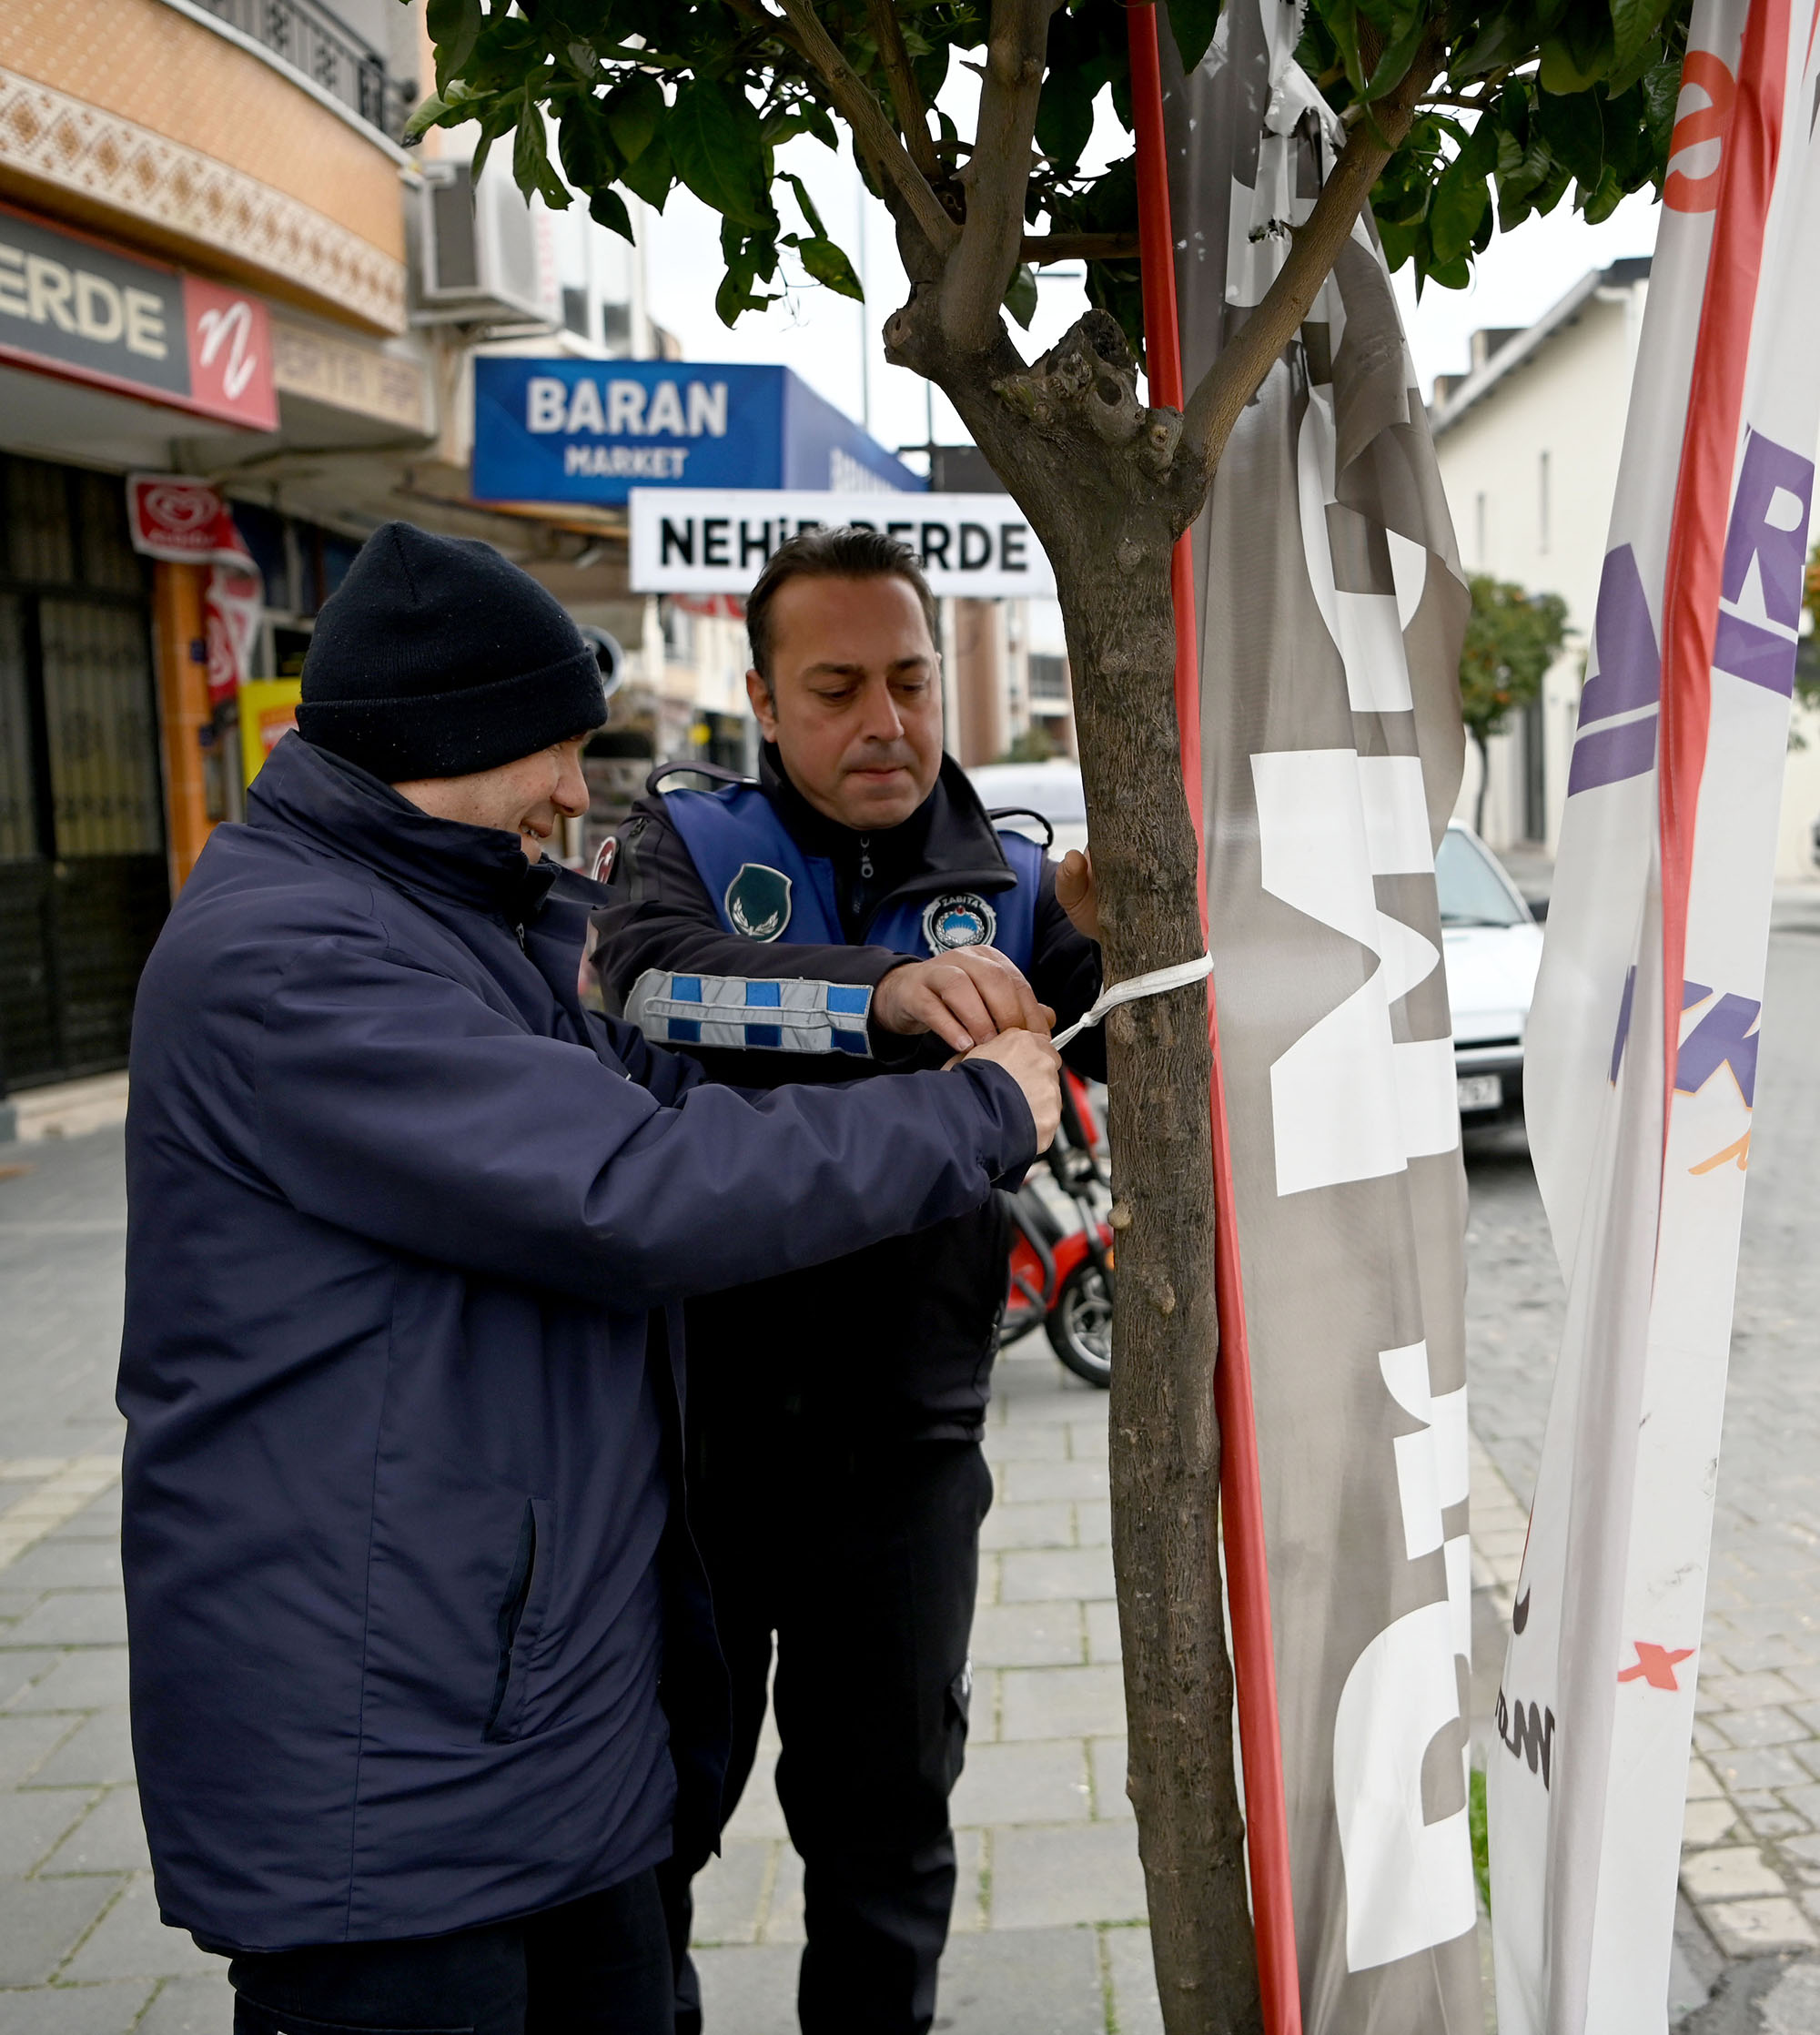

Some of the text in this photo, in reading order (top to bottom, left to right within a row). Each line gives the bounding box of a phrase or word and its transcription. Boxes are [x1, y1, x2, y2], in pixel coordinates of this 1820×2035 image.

[527, 377, 727, 437] BARAN
[564, 444, 689, 479] MARKET
[850, 521, 1027, 572] RDE
[942, 896, 979, 908] ZABITA
